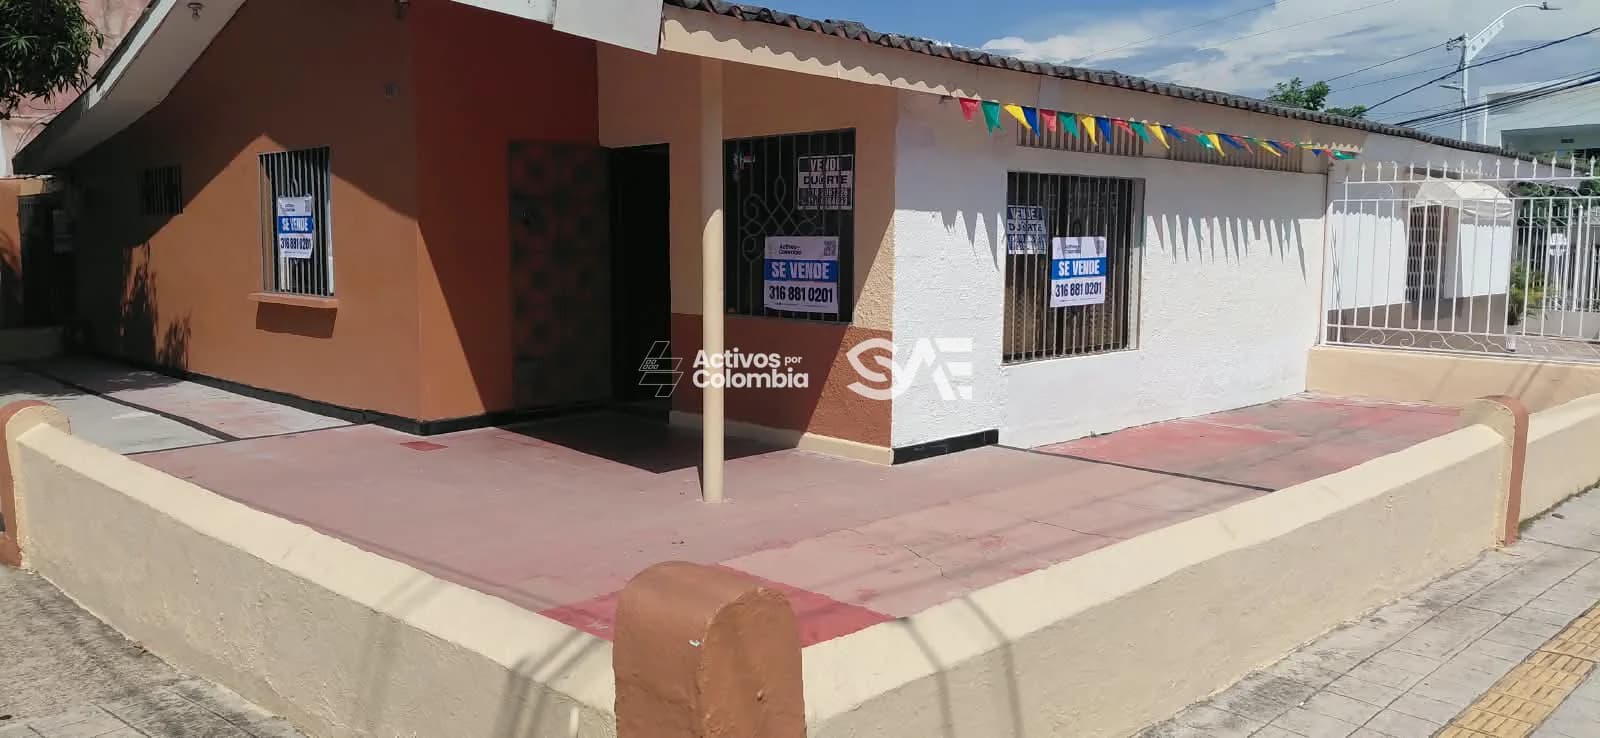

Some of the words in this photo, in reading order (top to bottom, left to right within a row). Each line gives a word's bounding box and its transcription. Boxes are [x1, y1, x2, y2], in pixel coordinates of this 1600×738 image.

[282, 217, 290, 231] SE
[290, 217, 309, 231] VENDE
[771, 261, 787, 278] SE
[789, 261, 830, 280] VENDE
[1058, 260, 1070, 277] SE
[1072, 259, 1100, 276] VENDE
[768, 284, 786, 300] 316
[788, 285, 806, 302] 881
[808, 287, 833, 303] 0201
[1055, 283, 1068, 298] 316
[1070, 282, 1083, 297] 881
[1084, 281, 1102, 296] 0201
